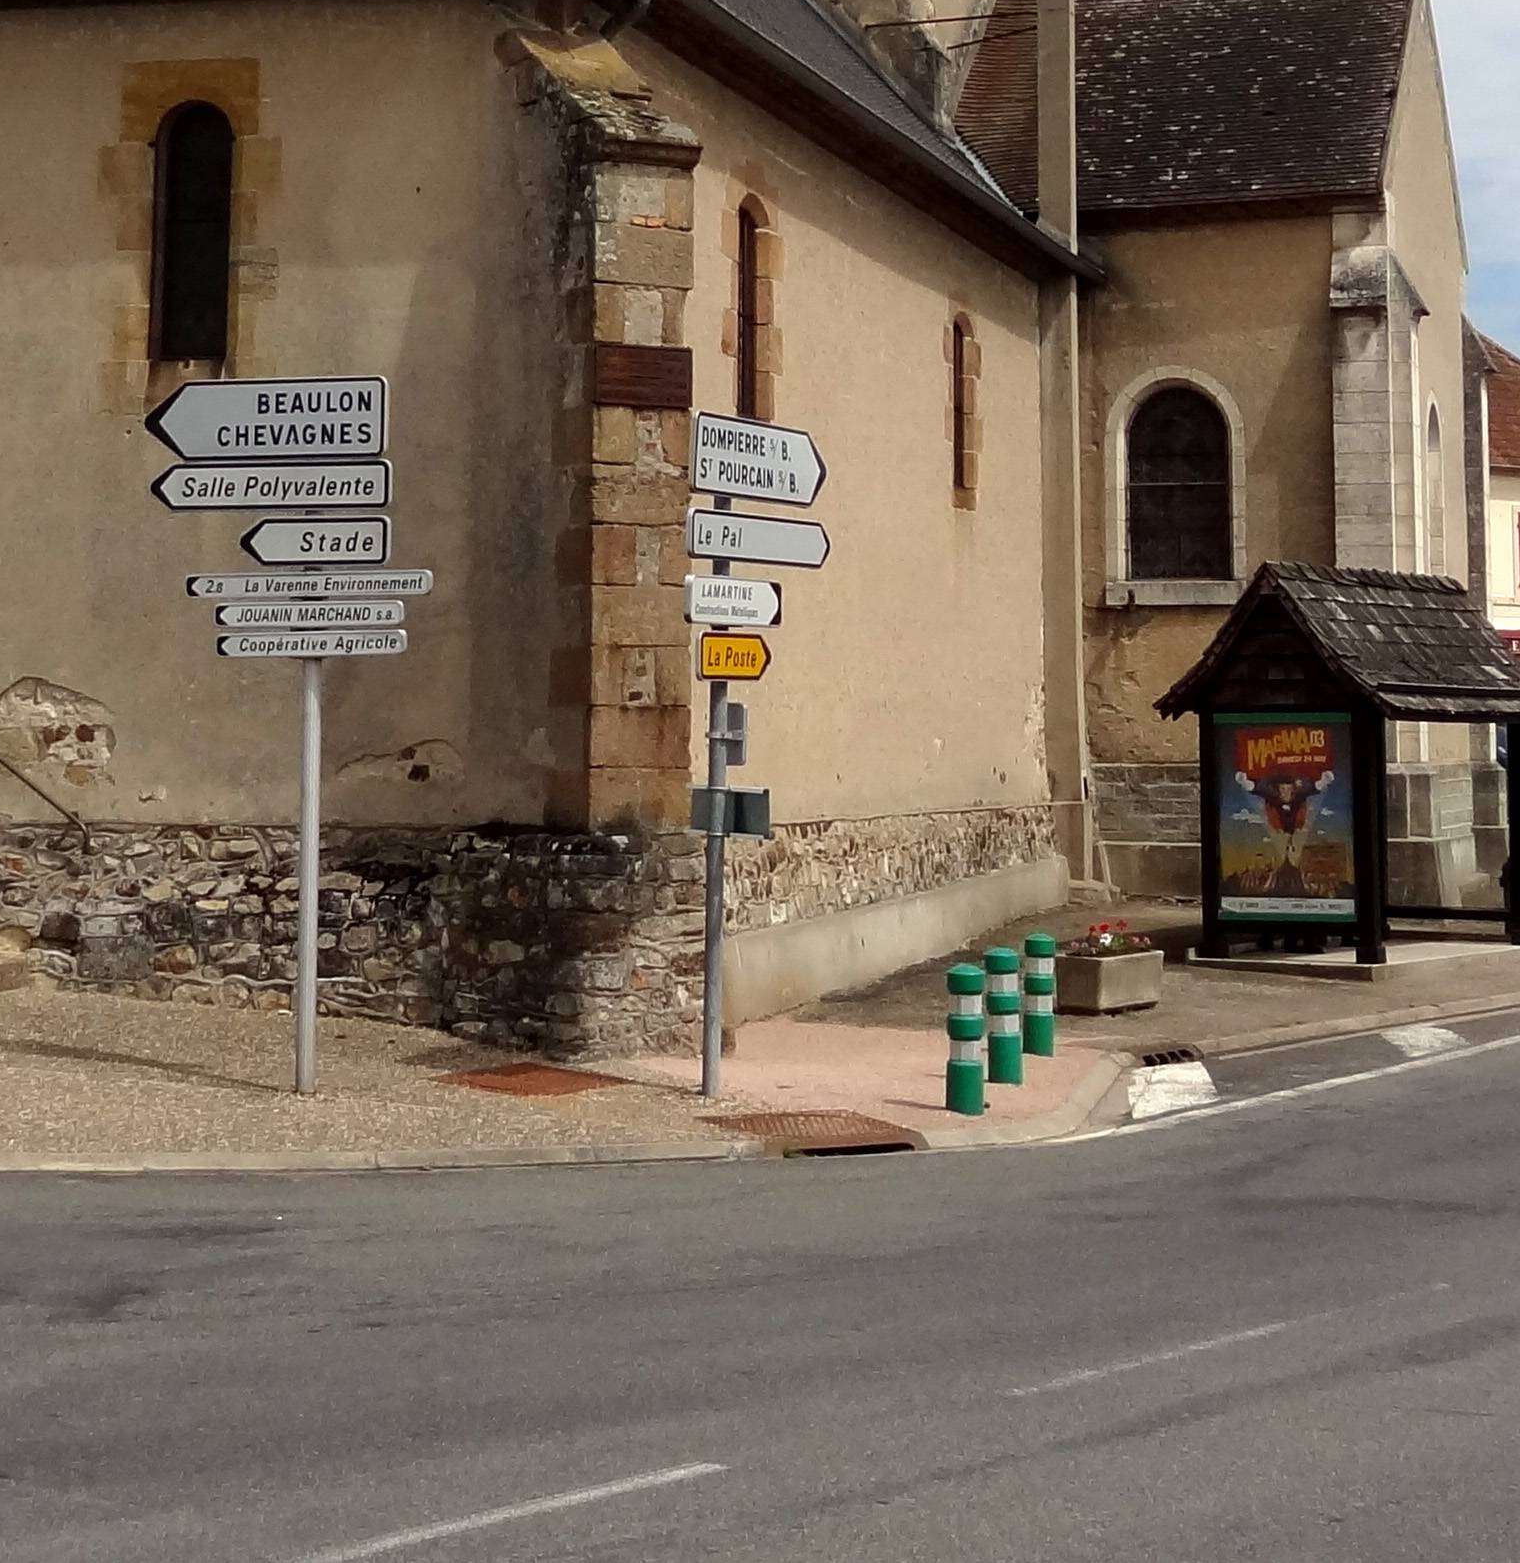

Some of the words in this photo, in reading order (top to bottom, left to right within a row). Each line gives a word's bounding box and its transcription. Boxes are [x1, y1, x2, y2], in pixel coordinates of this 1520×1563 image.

[257, 390, 372, 414] BEAULON
[217, 423, 372, 446] CHEVAGNES
[702, 426, 766, 457] DOMPIERRE
[718, 460, 774, 488] POURCAIN
[182, 477, 235, 497] Salle
[244, 476, 374, 501] Polyvalente
[300, 531, 374, 553] Stade
[698, 524, 712, 545] Le
[721, 526, 742, 548] Pal
[245, 579, 259, 592] La
[265, 578, 318, 592] Varenne
[324, 576, 423, 591] Environnement
[702, 584, 753, 601] LAMARTINE
[237, 608, 292, 623] JOUANIN
[297, 607, 371, 622] MARCHAND
[239, 637, 327, 654] Coopérative
[335, 635, 397, 653] Agricole
[707, 646, 720, 667] La
[725, 647, 757, 668] Poste
